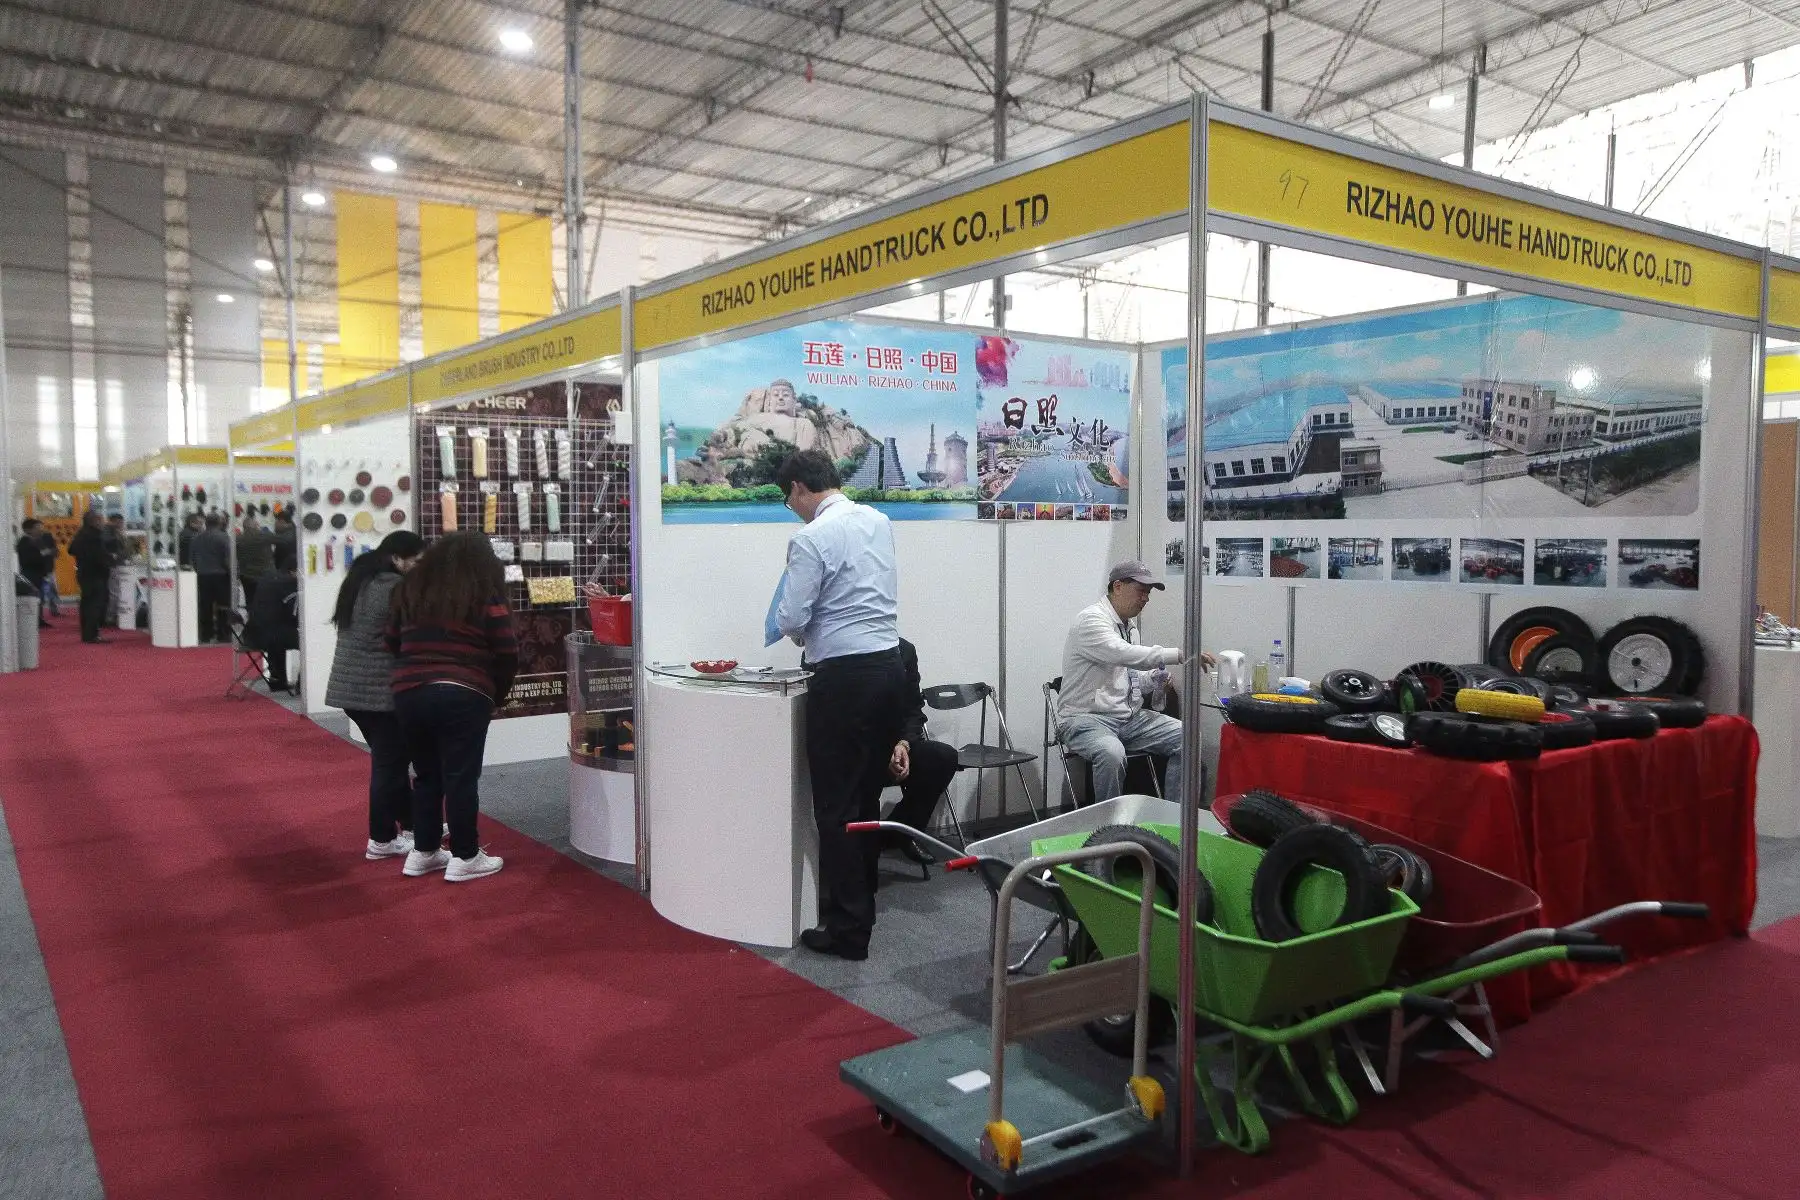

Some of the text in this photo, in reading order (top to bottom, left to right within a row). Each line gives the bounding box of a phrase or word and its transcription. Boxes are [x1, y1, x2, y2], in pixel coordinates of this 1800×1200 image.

[1279, 168, 1309, 208] 97
[1346, 180, 1692, 287] RIZHAO YOUHE HANDTRUCK CO.,LTD
[701, 193, 1049, 317] RIZHAO YOUHE HANDTRUCK CO.,LTD
[503, 346, 540, 370] INDUSTRY
[803, 342, 957, 374] 五莲 日照 中国
[807, 372, 957, 392] WULIAN RIZHAO CHINA
[514, 682, 541, 691] INDUSTRY
[530, 689, 541, 697] EXP
